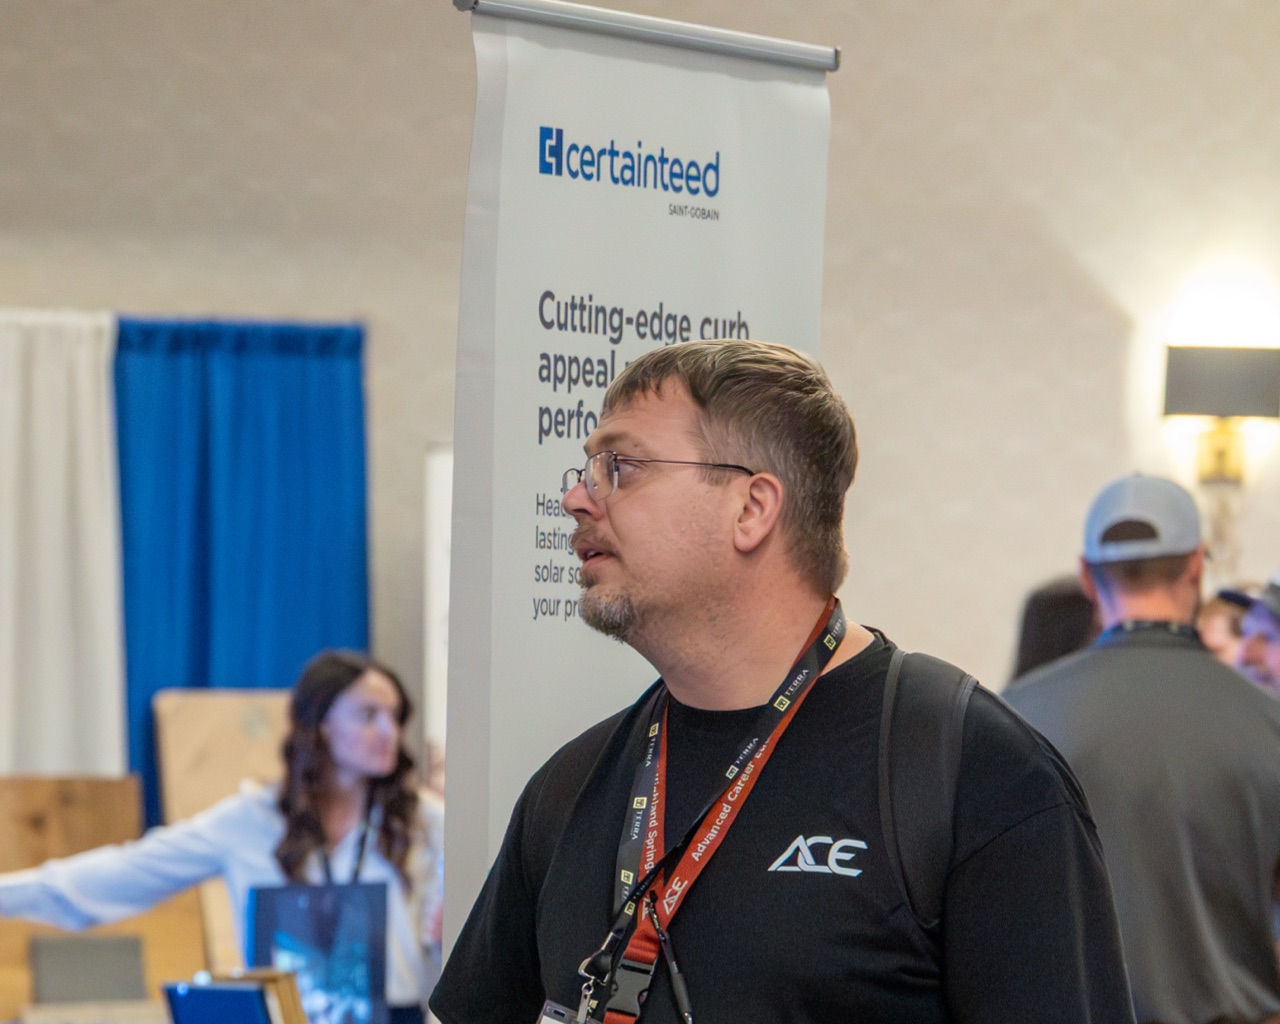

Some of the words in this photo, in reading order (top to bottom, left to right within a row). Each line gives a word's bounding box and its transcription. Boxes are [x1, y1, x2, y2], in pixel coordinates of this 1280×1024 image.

[566, 139, 720, 198] certainteed
[668, 203, 720, 221] SAINT-GOBAIN
[538, 290, 691, 345] Cutting-edge
[538, 349, 616, 393] appeal
[534, 559, 565, 583] solar
[532, 597, 561, 621] your
[784, 668, 810, 697] TERRA
[631, 809, 644, 841] TERRA
[691, 802, 732, 862] Advanced
[727, 759, 755, 801] Career
[767, 834, 869, 878] ACE
